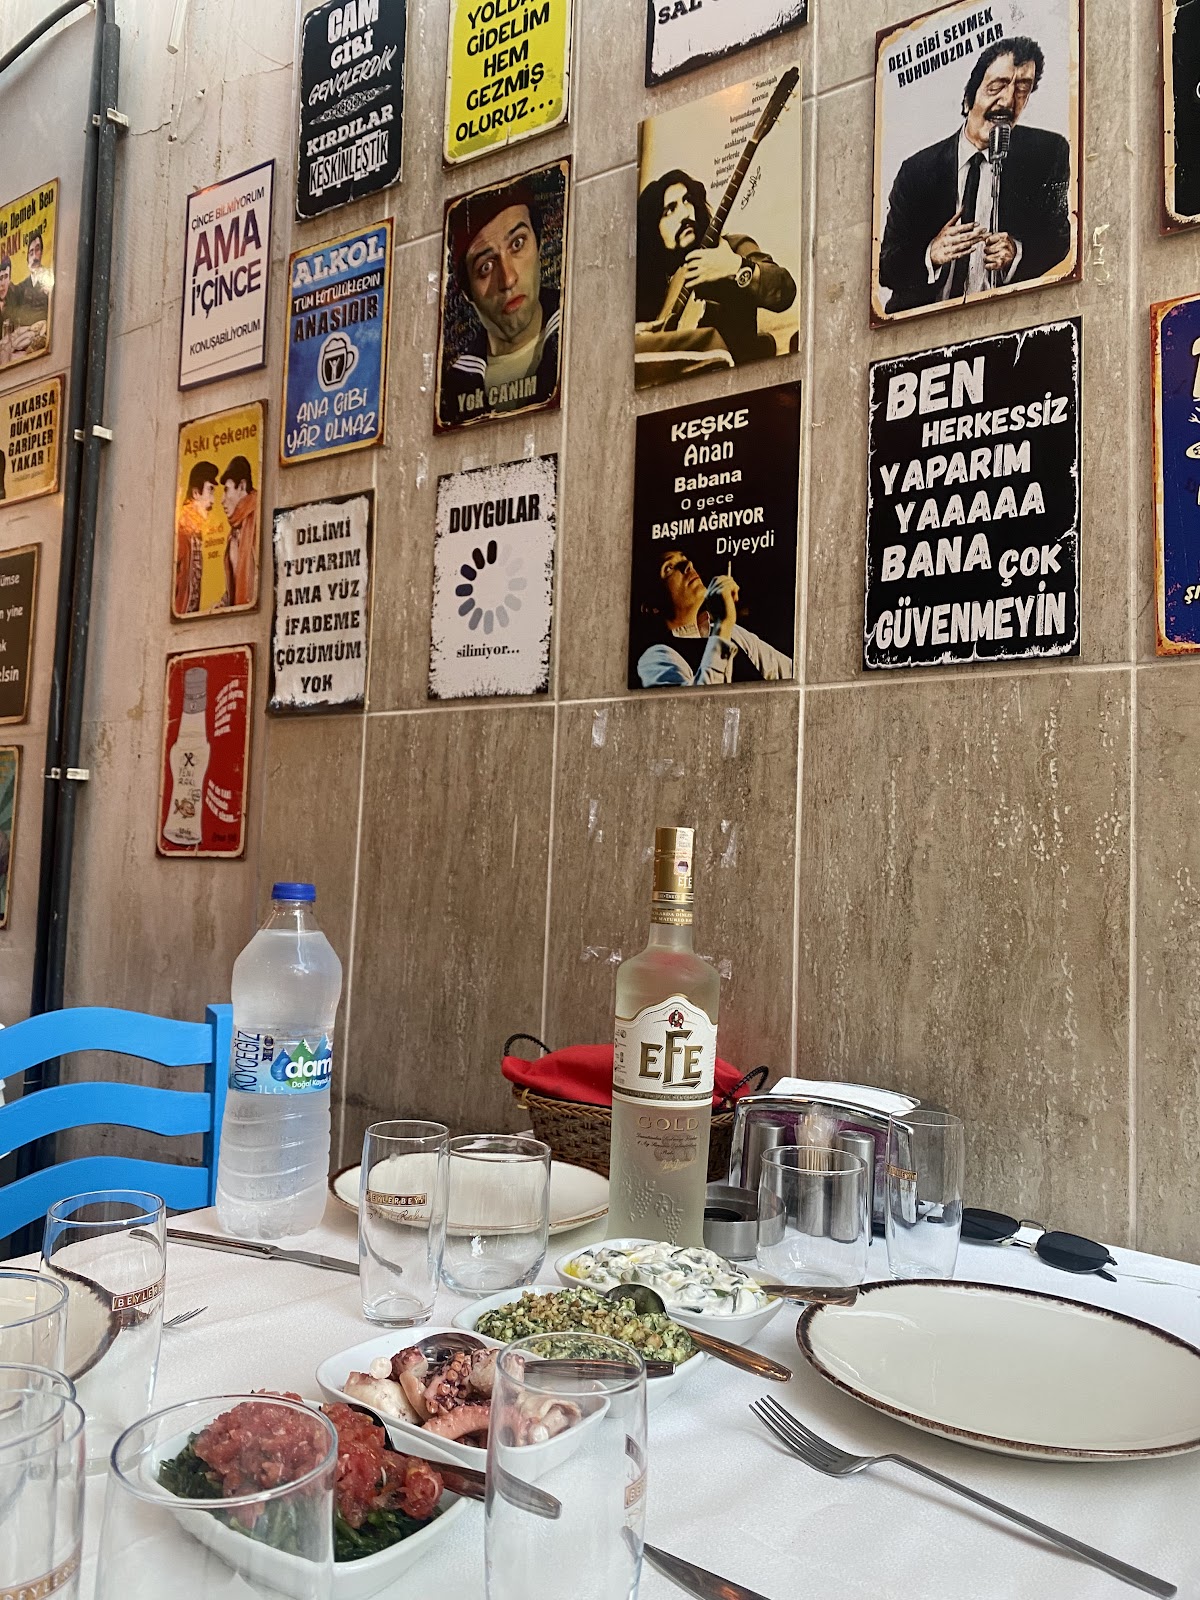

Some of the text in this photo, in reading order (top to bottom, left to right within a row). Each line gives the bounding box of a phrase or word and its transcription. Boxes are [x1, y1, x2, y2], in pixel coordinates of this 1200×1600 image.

[467, 2, 549, 56] GİDELİM
[468, 0, 535, 29] YOLD
[330, 28, 373, 69] GİBİ
[888, 6, 993, 73] DELİ GİBİ SEVMEK
[897, 23, 1004, 88] RUHUMUZDA VAR
[308, 45, 397, 107] GENÇLERDİK
[484, 40, 528, 78] HEM
[466, 62, 544, 111] GEZMİŞ
[306, 104, 394, 157] KIRDILAR
[455, 97, 553, 142] OLURUZ...
[10, 198, 36, 230] Demek
[39, 188, 54, 210] Ben
[215, 186, 264, 220] BİLMİYORUM
[193, 207, 262, 277] AMA
[293, 236, 384, 289] ALKOL
[294, 294, 379, 343] ANASIDIR
[190, 318, 261, 356] KONUŞABİLİYORUM
[9, 389, 55, 419] YAKARSA
[297, 388, 368, 423] ANA GİBİ
[457, 375, 538, 413] Yok CANIM
[885, 356, 985, 422] BEN
[10, 410, 53, 438] DÜNYAYI
[325, 412, 376, 442] OLMAZ
[671, 409, 749, 441] KEŞKE
[922, 391, 1069, 448] HERKESSİZ
[8, 429, 54, 457] GARİPLER
[184, 424, 257, 457] Aşkı çekene
[683, 440, 734, 467] Anan
[674, 469, 742, 493] Babana
[879, 439, 1031, 496] YAPARIM
[449, 493, 540, 534] DUYGULAR
[681, 492, 734, 511] O gece
[895, 481, 1046, 534] YAAAAA
[296, 516, 351, 546] DİLİMİ
[652, 507, 764, 541] BAŞIM AĞRIYOR
[716, 529, 775, 556] Diyeydi
[881, 532, 1063, 587] BANA ÇOK
[284, 549, 361, 577] TUTARIM
[284, 579, 360, 607] AMA YÜZ
[7, 605, 23, 622] yine
[285, 610, 360, 636] İFADEME
[875, 580, 1066, 651] GÜVENMEYİN
[276, 641, 361, 671] ÇÖZÜMÜM
[456, 643, 520, 659] siliniyor...
[301, 674, 333, 693] YOK
[639, 1029, 703, 1090] EFE
[638, 1116, 699, 1131] GOLD
